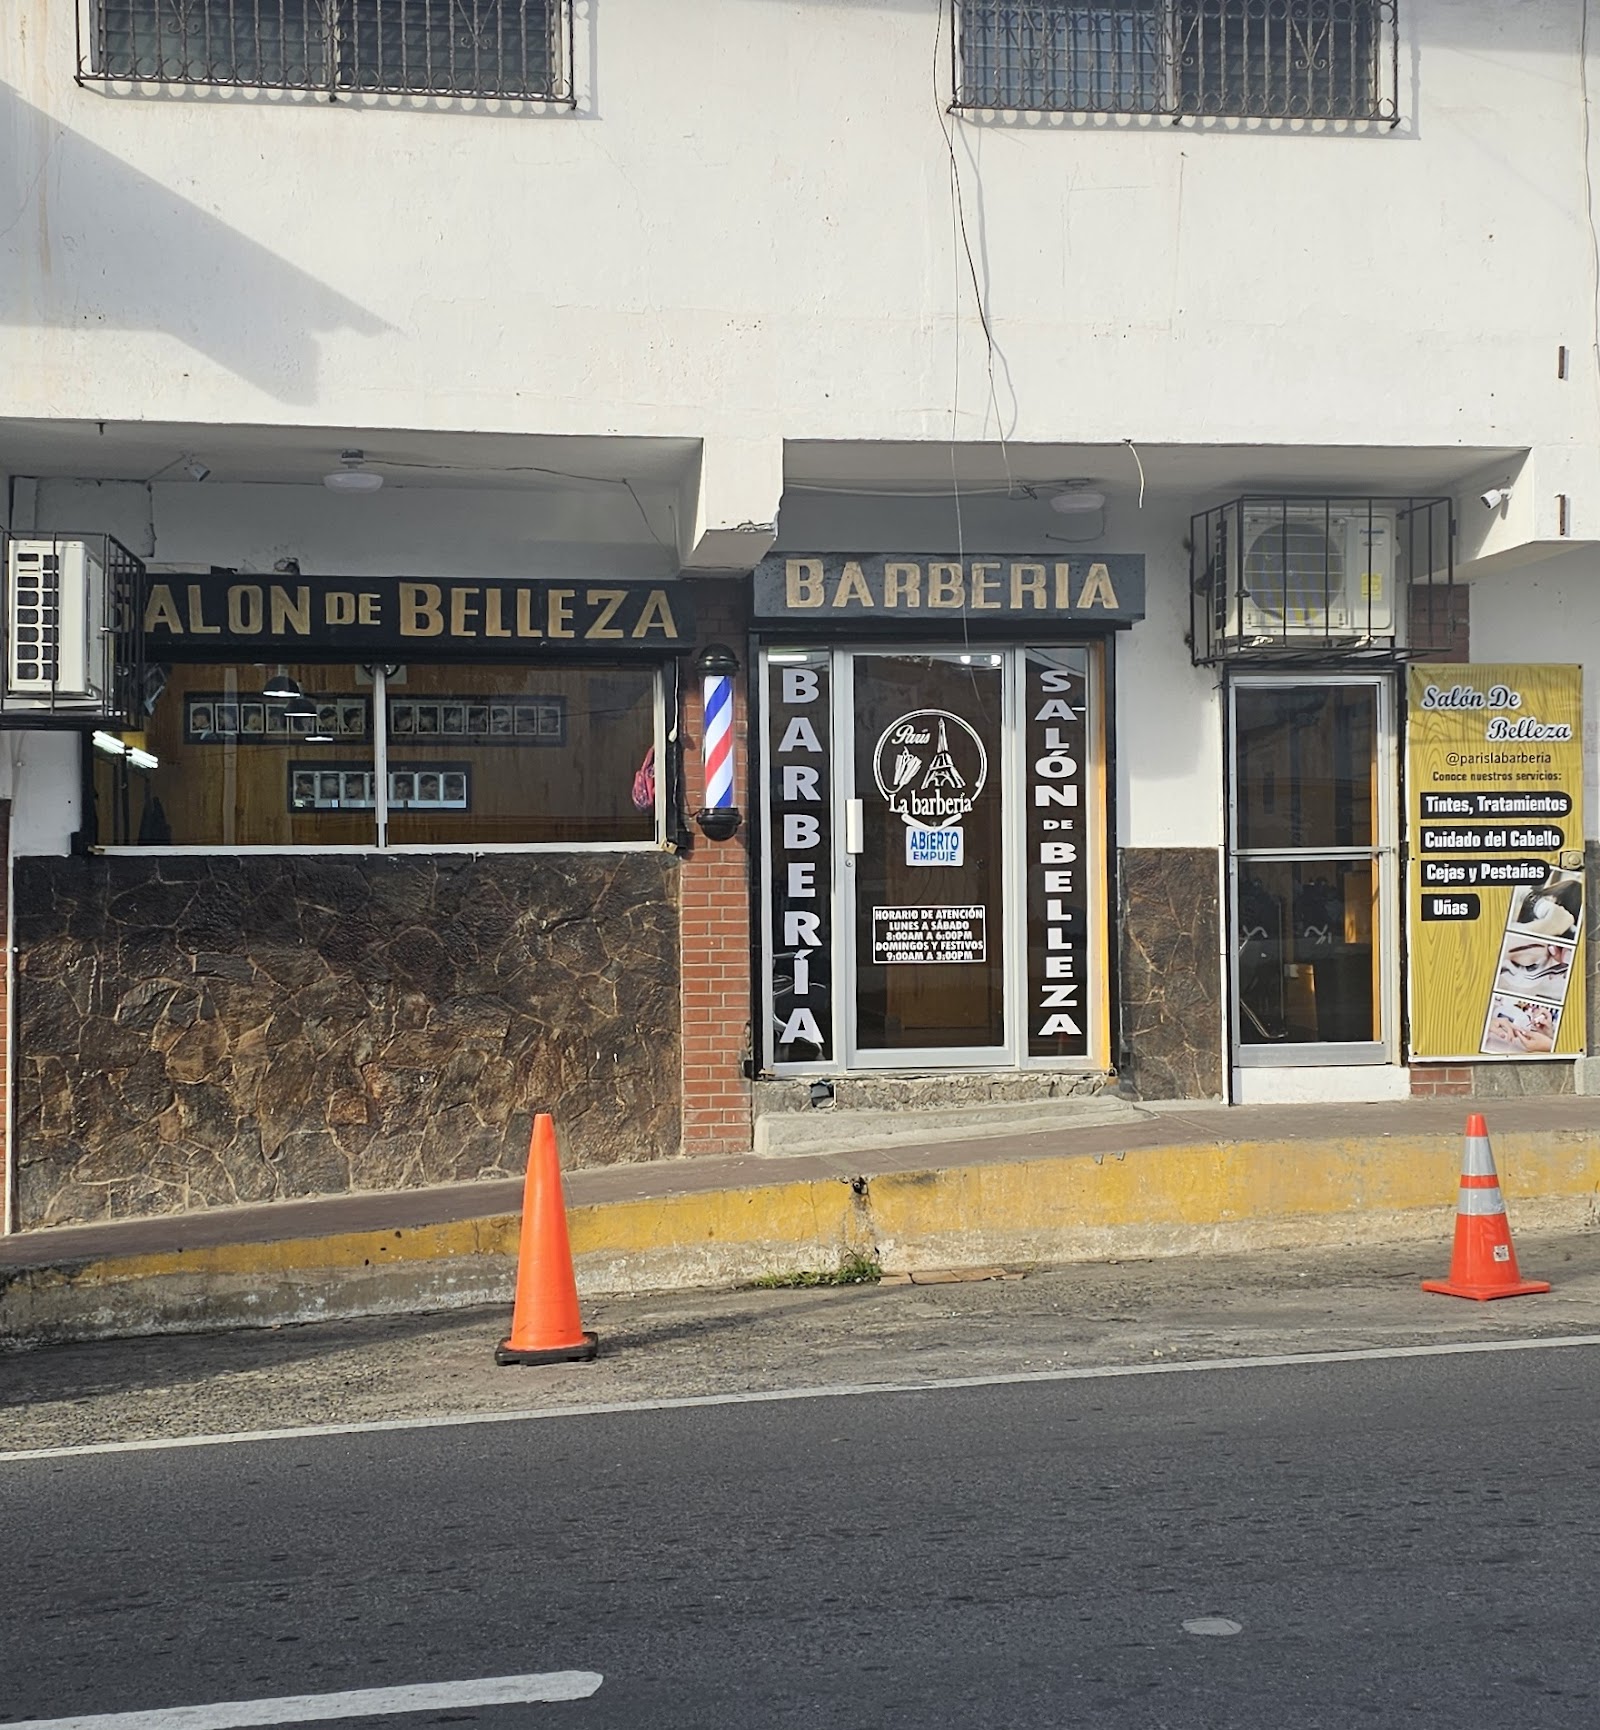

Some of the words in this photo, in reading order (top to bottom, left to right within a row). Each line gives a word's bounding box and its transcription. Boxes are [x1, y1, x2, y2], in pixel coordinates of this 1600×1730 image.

[784, 558, 1120, 610] BARBERIA
[325, 591, 381, 625] DE
[399, 581, 679, 639] BELLEZA
[1423, 686, 1485, 708] Salón
[1489, 686, 1520, 708] De
[891, 724, 931, 745] Paris
[1034, 669, 1078, 808] SALÓN
[1487, 718, 1571, 740] Belleza
[1432, 771, 1468, 782] Conoce
[1470, 771, 1513, 781] nuestros
[1516, 770, 1562, 781] servicios:
[889, 793, 909, 815] La
[1425, 796, 1474, 815] Tintes,
[1476, 794, 1568, 813] Tratamientos
[1042, 819, 1074, 831] DE
[910, 831, 959, 851] ABIERTO
[1424, 830, 1481, 848] Cuidado
[1484, 830, 1507, 848] del
[1509, 829, 1561, 848] Cabello
[777, 668, 825, 1044] BARBERÍA
[913, 851, 957, 862] EMPUJE
[1426, 863, 1466, 883] Cejas
[1468, 867, 1478, 883] y
[1480, 862, 1545, 880] Pestañas
[875, 909, 919, 921] HORARIO
[920, 909, 934, 920] DE
[935, 907, 983, 920] ATENCIÓN
[1432, 898, 1469, 916] Uñas
[889, 921, 920, 931] LUNES
[921, 921, 930, 931] A
[931, 919, 970, 931] SÁBADO
[886, 931, 924, 941] 8:00AM
[926, 931, 934, 941] A
[935, 930, 973, 941] 6:00PM
[1037, 841, 1083, 1036] BELLEZA
[875, 941, 930, 952] DOMINGOS
[931, 941, 939, 951] Y
[940, 940, 984, 951] FESTIVOS
[886, 951, 924, 961] 9:00AM
[926, 951, 934, 961] A
[935, 951, 973, 961] 3:00PM
